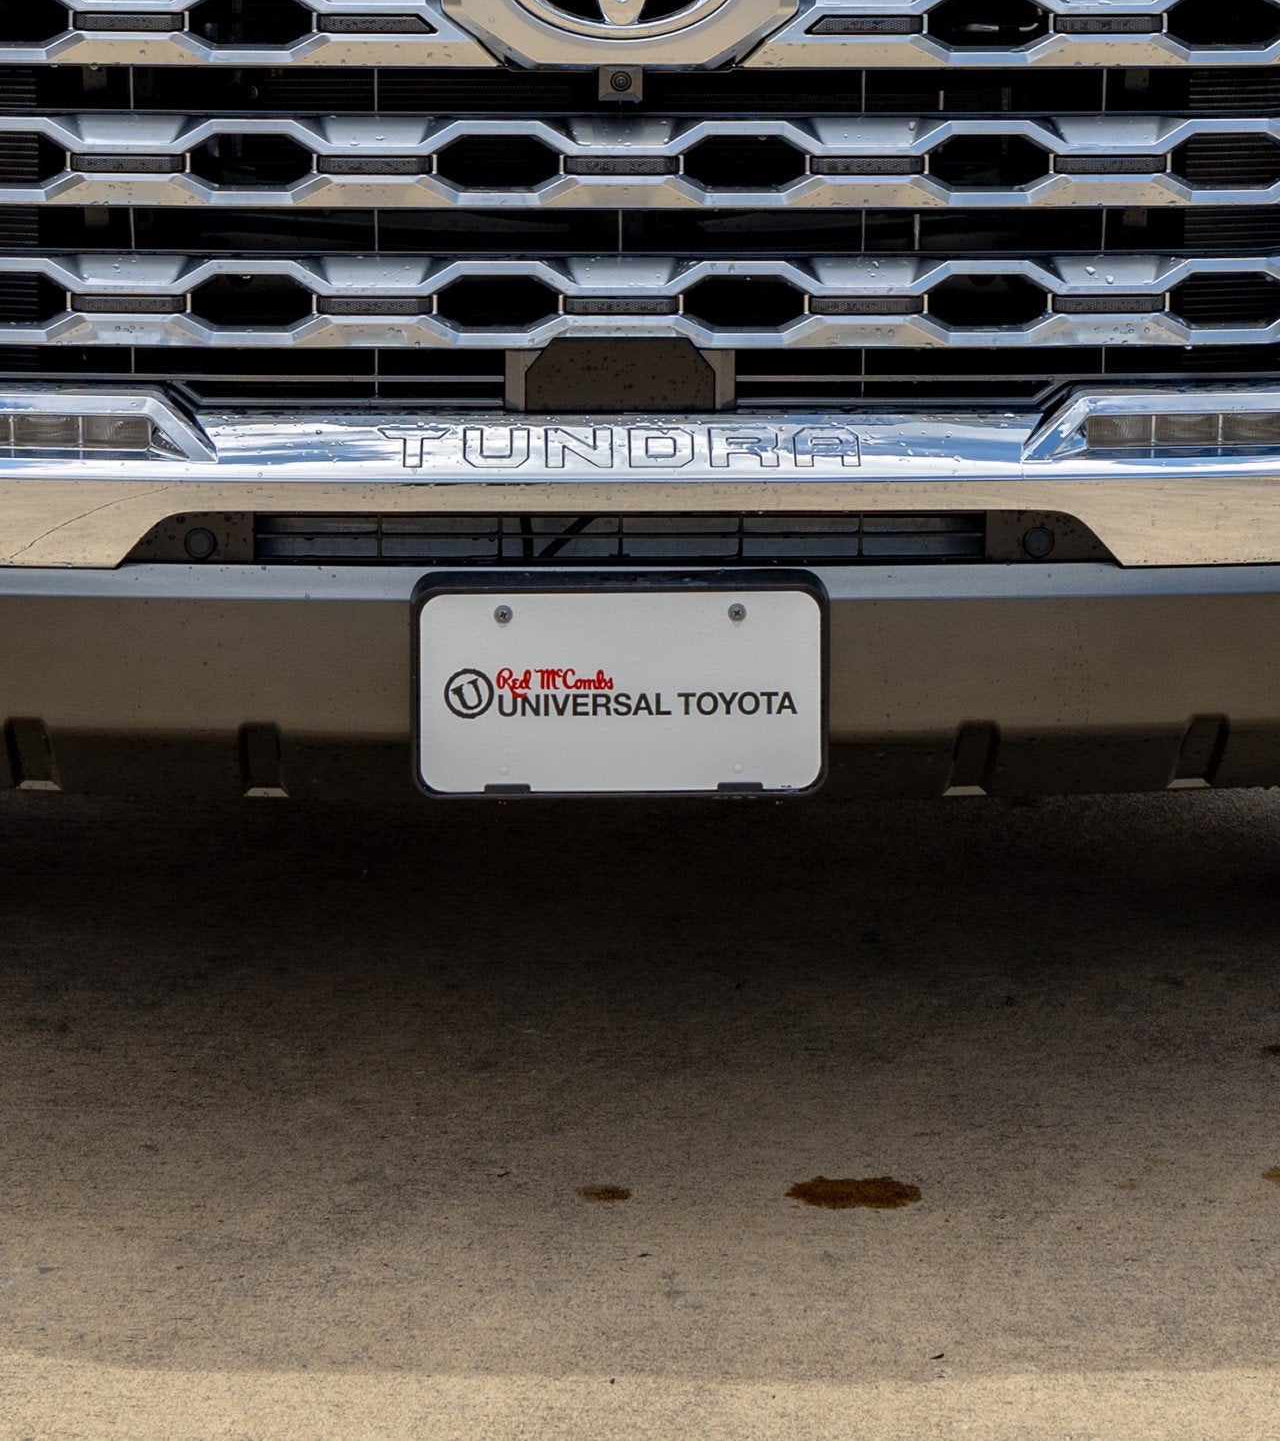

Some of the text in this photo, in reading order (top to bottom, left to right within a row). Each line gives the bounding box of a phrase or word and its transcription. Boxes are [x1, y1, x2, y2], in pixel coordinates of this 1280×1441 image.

[376, 425, 861, 468] TUNDRA
[496, 668, 614, 698] Red McCombs
[498, 692, 798, 717] UNIVERSAL TOYOTA
